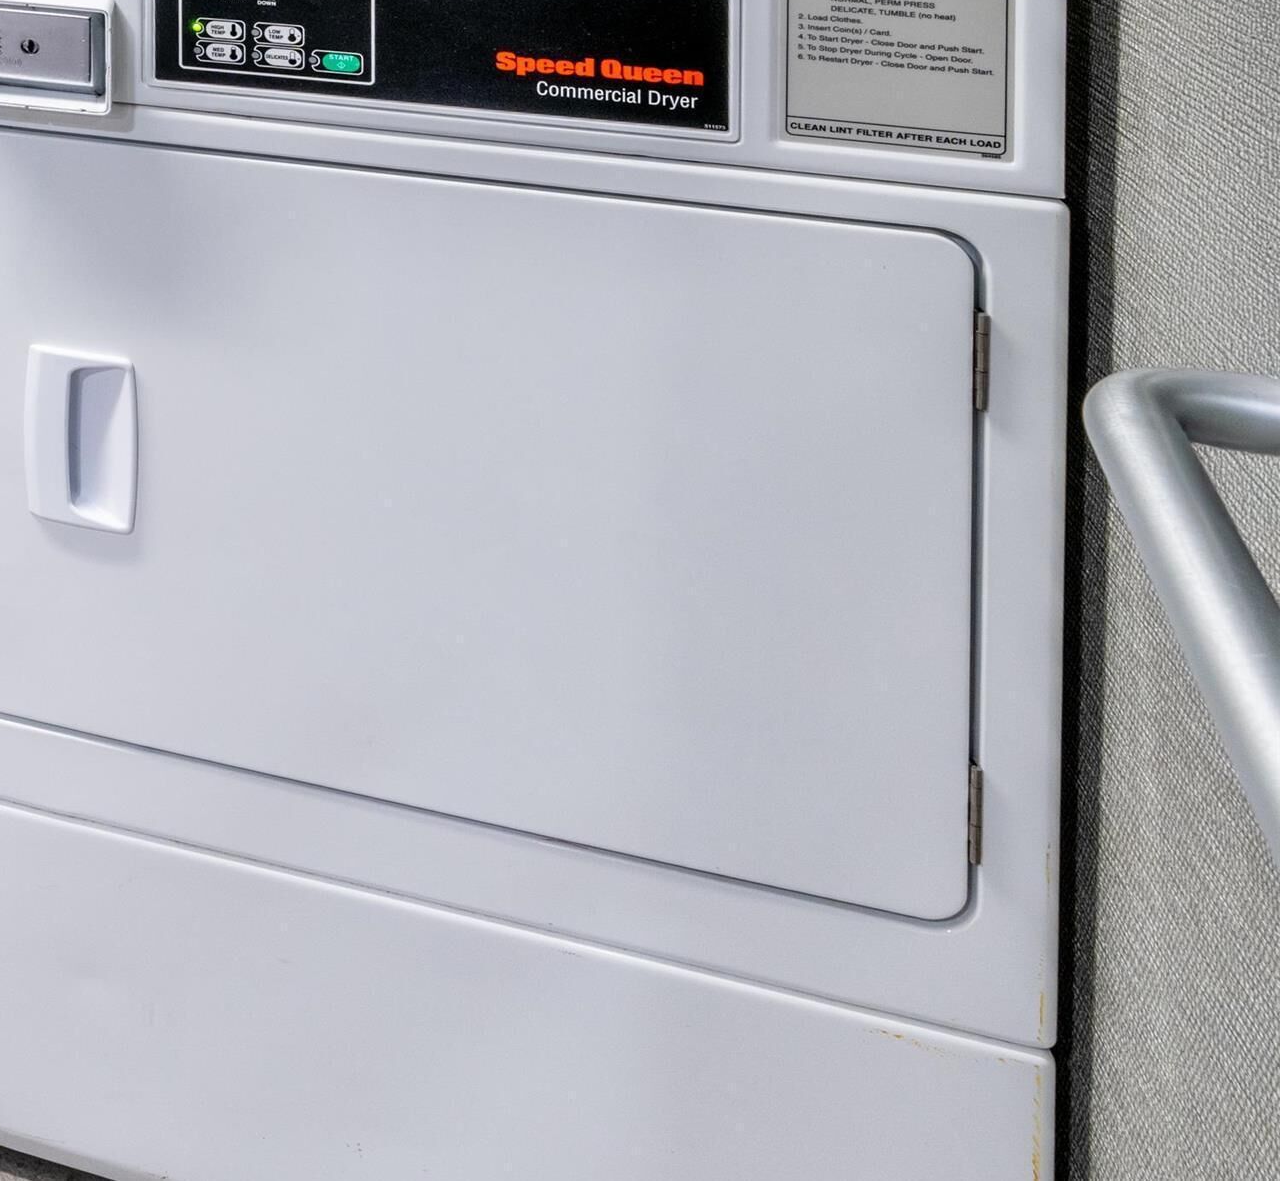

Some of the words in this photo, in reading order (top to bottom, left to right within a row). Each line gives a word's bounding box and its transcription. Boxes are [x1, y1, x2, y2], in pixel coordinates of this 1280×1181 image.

[807, 14, 828, 22] Load
[830, 16, 862, 24] Clothes.
[831, 6, 877, 16] DELICATE,
[879, 9, 916, 18] TUMBLE
[918, 12, 931, 20] (no
[934, 13, 956, 21] heat)
[807, 24, 831, 32] Insert
[833, 25, 862, 35] Coin(s)
[819, 35, 839, 43] Start
[841, 36, 863, 46] Dryer
[871, 39, 895, 47] Close
[897, 41, 917, 49] Door
[938, 44, 958, 52] Push
[960, 46, 984, 54] Start.
[819, 44, 838, 54] Stop
[840, 46, 862, 56] Dryer
[864, 48, 892, 58] During
[894, 51, 917, 60] Cycle
[925, 54, 948, 63] Open
[950, 56, 973, 64] Door.
[495, 51, 595, 77] Speed
[601, 59, 704, 86] Queen
[819, 55, 848, 63] Restart
[851, 57, 873, 66] Dryer
[881, 60, 904, 68] Close
[906, 62, 927, 70] Door
[948, 65, 969, 74] Push
[971, 67, 994, 76] Start.
[536, 81, 641, 104] Commercial
[648, 91, 698, 110] Dryer
[790, 122, 826, 132] CLEAN
[829, 125, 853, 134] LINT
[856, 127, 893, 139] FILTER
[896, 132, 932, 143] AFTER
[936, 136, 966, 145] EACH
[970, 139, 1001, 149] LOAD
